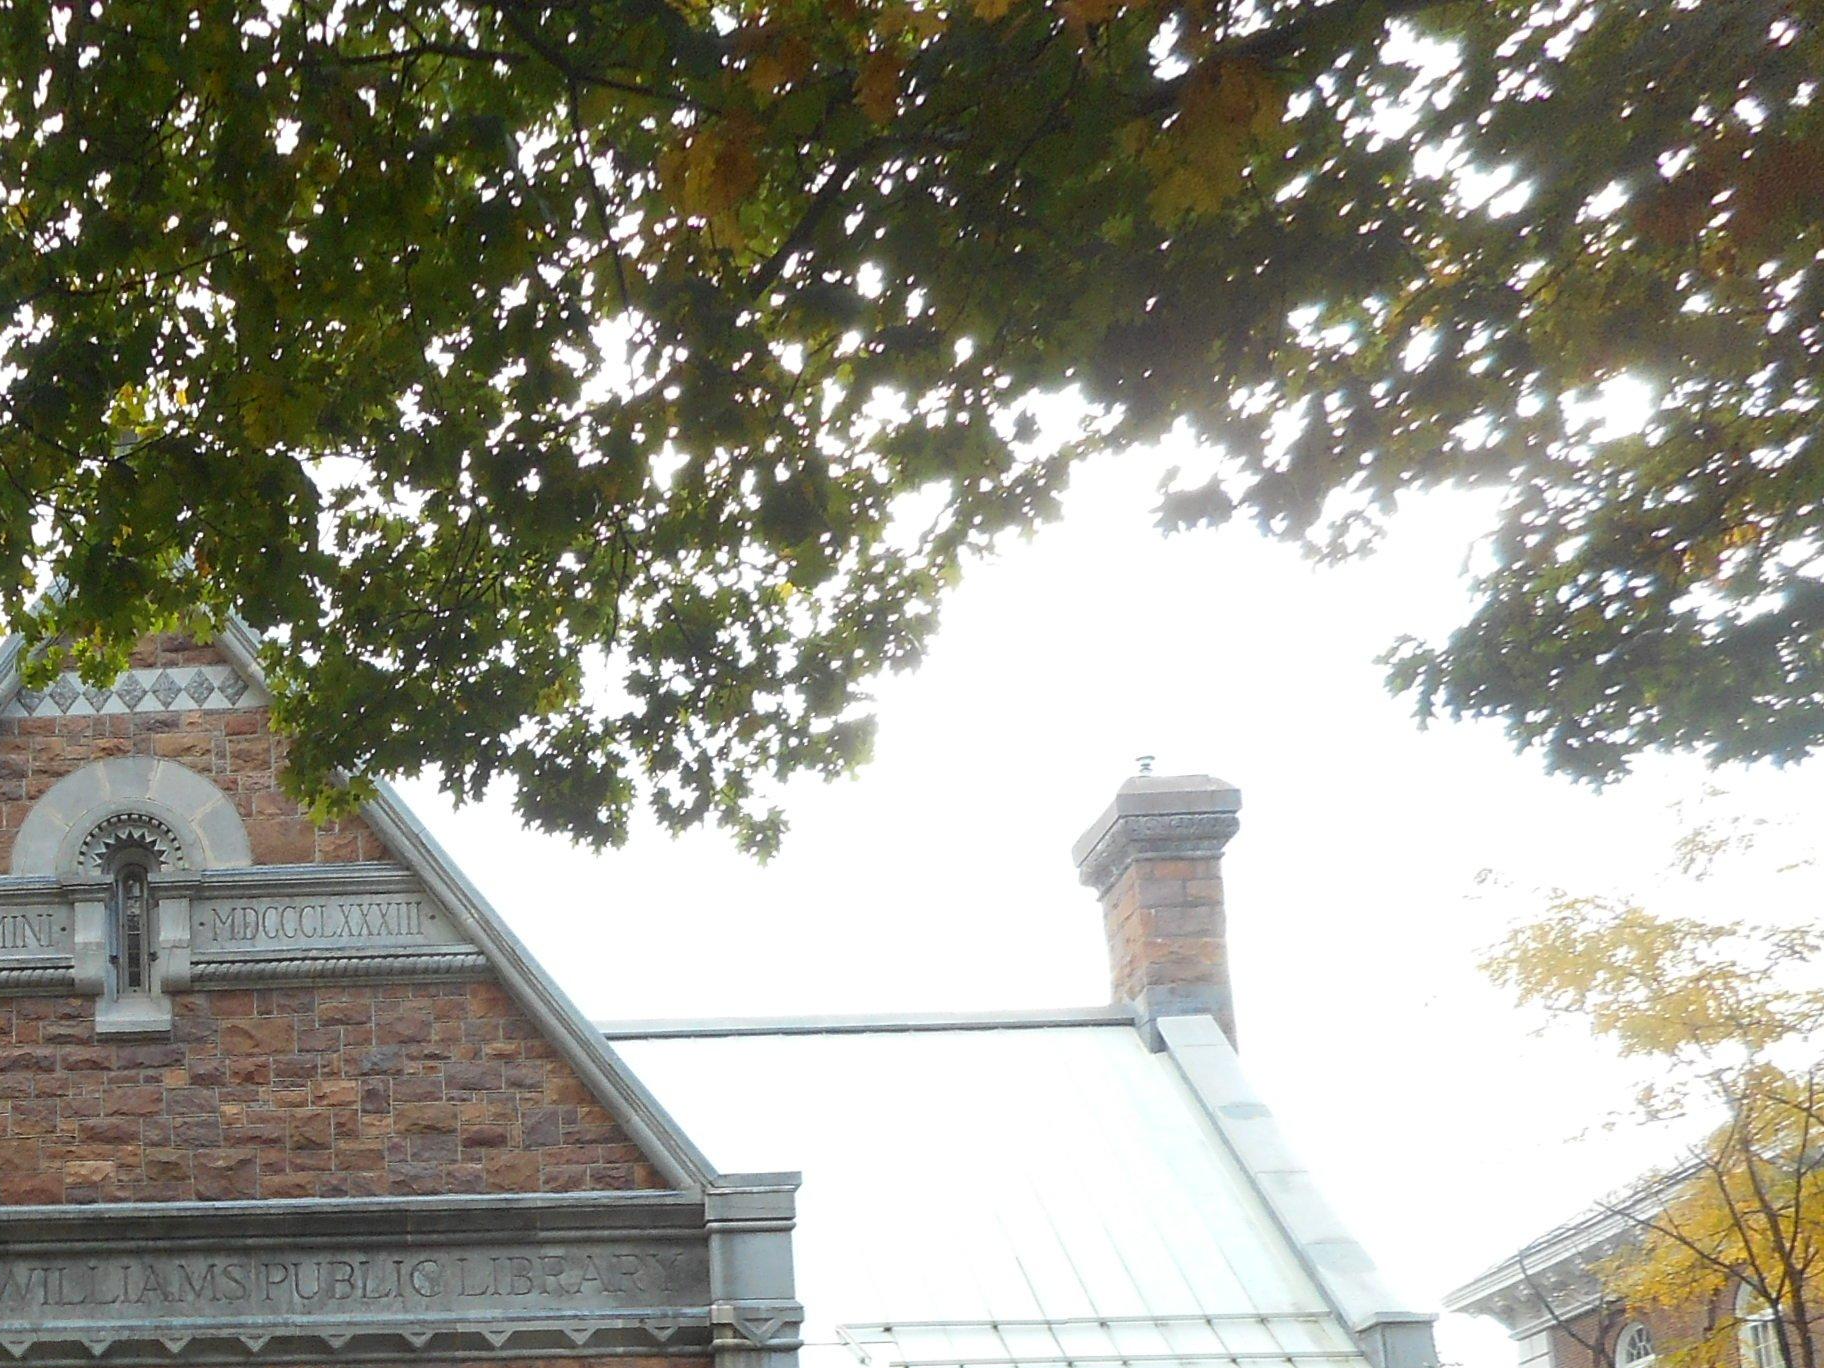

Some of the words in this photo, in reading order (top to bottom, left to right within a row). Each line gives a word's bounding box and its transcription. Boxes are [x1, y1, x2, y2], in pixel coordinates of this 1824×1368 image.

[210, 900, 425, 942] MDCCCLXXXIII
[261, 1258, 441, 1301] PUBLIC
[456, 1252, 683, 1298] LIBRARY
